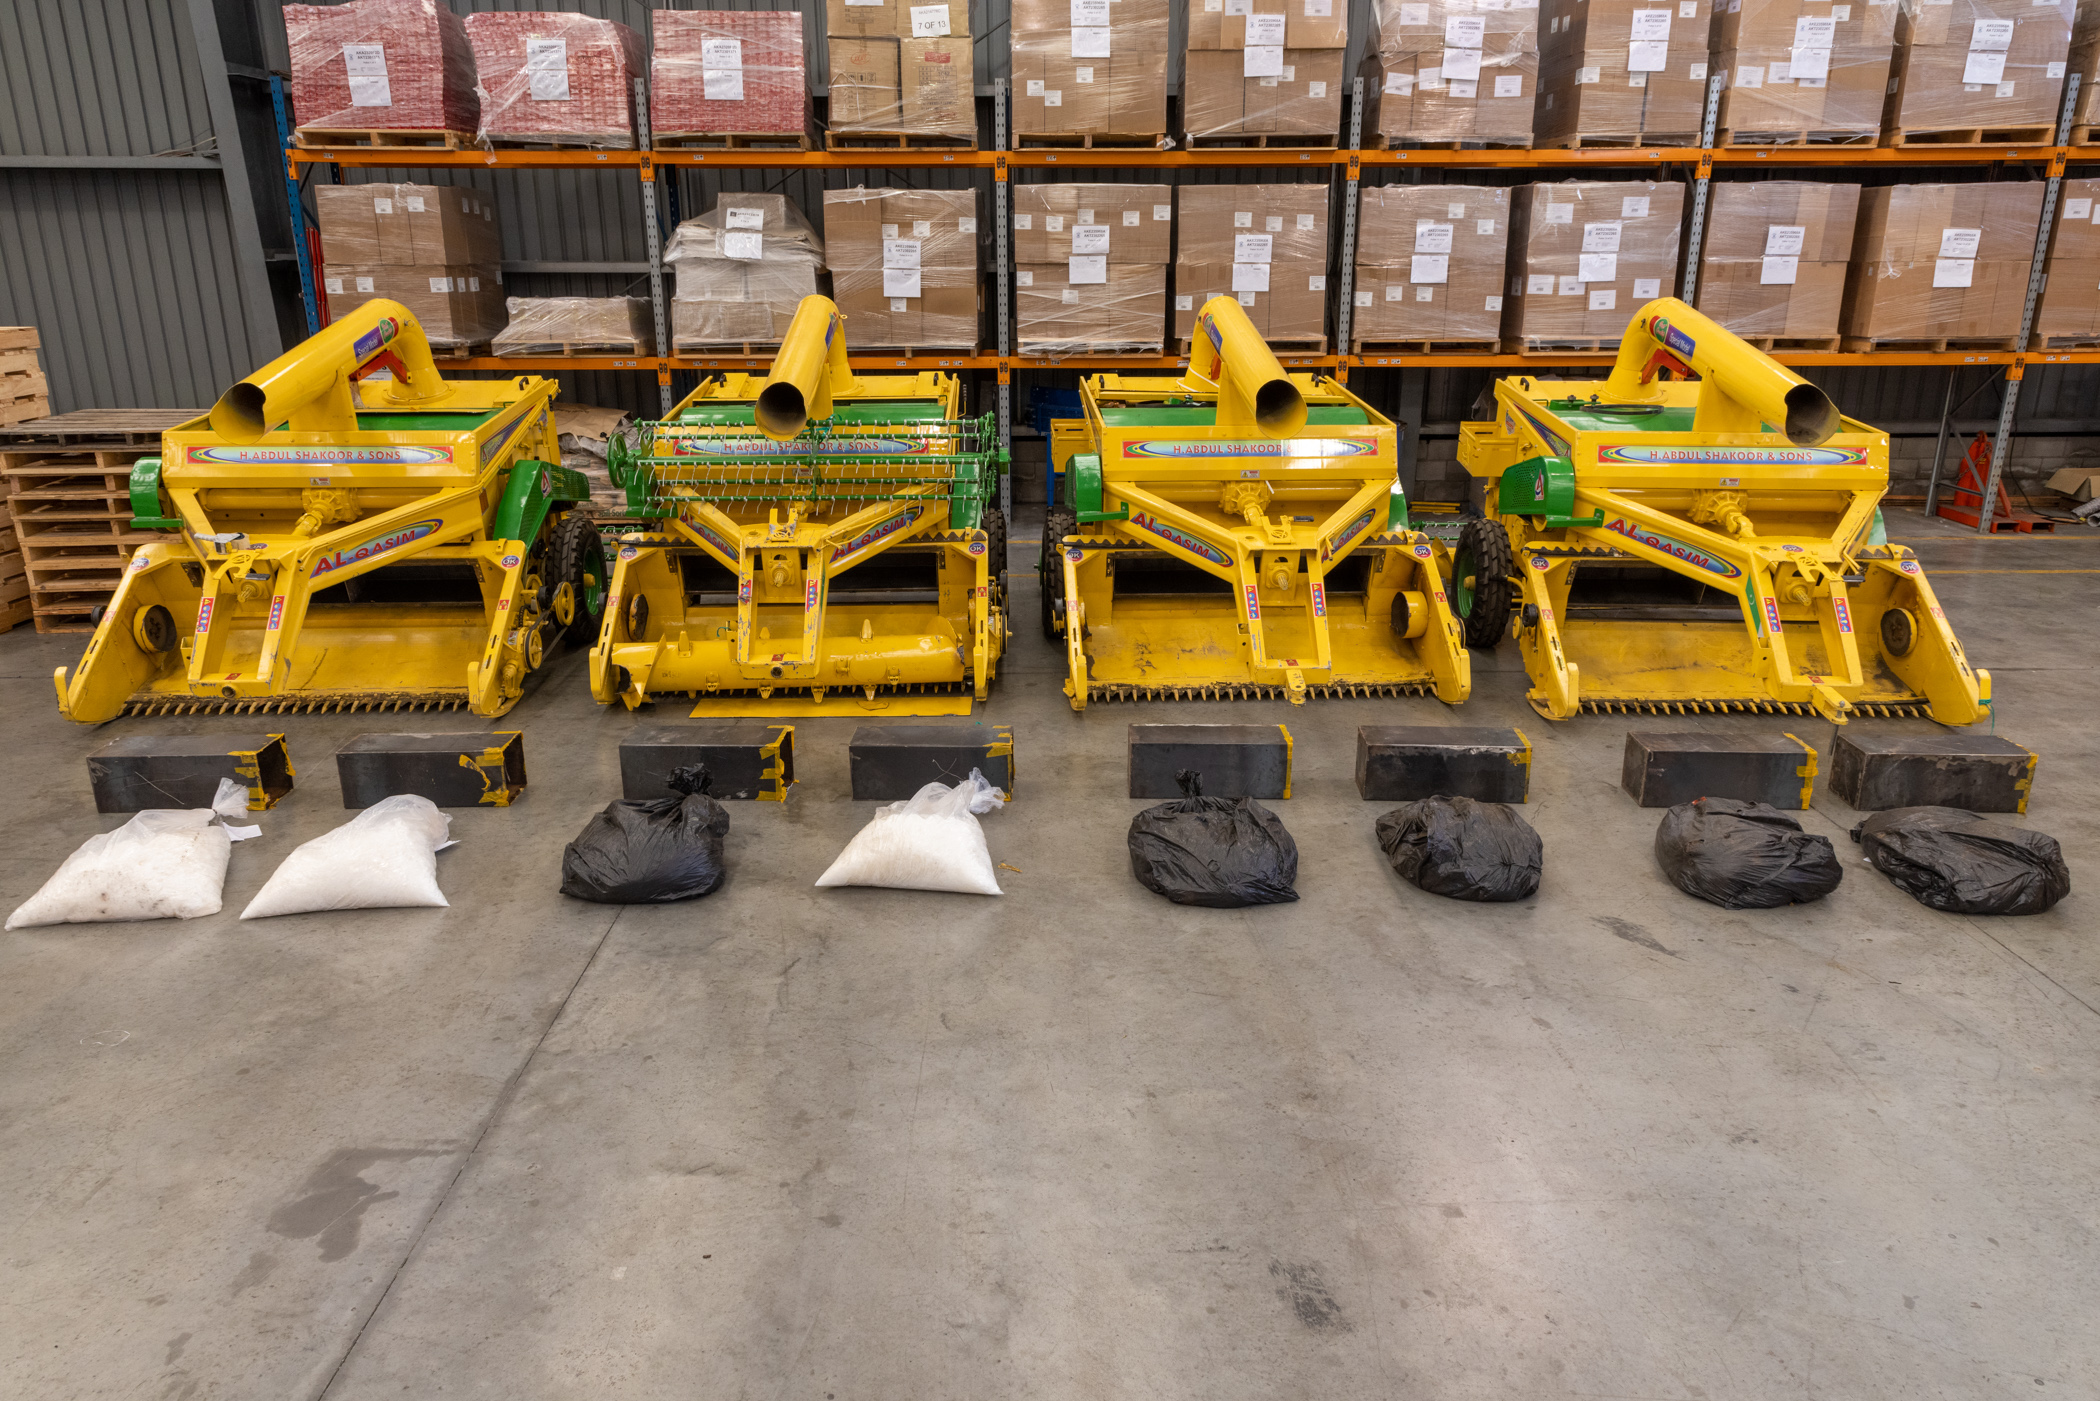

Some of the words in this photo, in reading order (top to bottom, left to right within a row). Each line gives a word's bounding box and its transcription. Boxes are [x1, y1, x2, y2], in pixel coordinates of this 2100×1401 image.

[925, 21, 935, 29] OF
[837, 442, 844, 450] &
[850, 442, 879, 450] SONS
[1174, 445, 1223, 454] H.ABDUL
[1227, 444, 1282, 453] SHAKOOR
[240, 451, 292, 460] H.ABDUL
[296, 451, 353, 460] SHAKOOR
[357, 451, 365, 460] &
[369, 451, 400, 460] SONS
[1650, 451, 1702, 460] H.ABDUL
[1705, 451, 1764, 460] SHAKOOR
[1767, 452, 1776, 460] &
[1780, 452, 1813, 461] SONS
[833, 516, 904, 559] AL-QASIM
[1134, 513, 1210, 557] AL-QASIM
[1608, 518, 1709, 567] AL-QASIM
[314, 530, 415, 575] AL-QASIM
